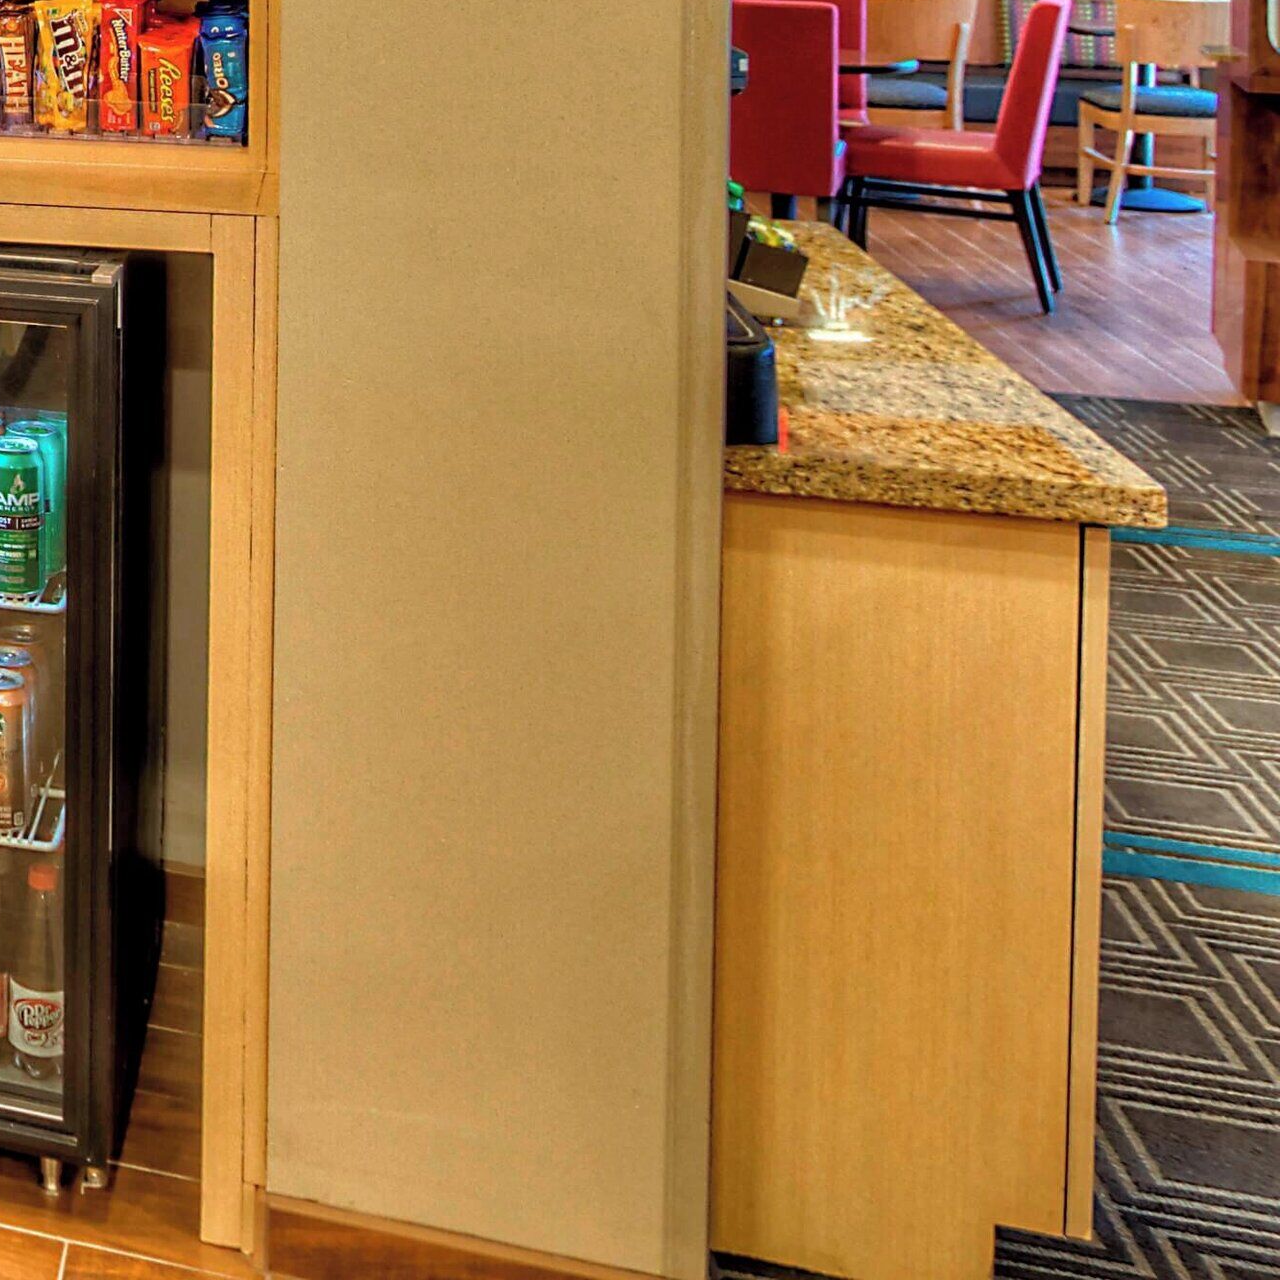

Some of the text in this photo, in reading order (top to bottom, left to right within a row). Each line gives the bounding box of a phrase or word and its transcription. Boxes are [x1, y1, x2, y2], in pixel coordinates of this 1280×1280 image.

[0, 36, 28, 112] HEATH
[111, 19, 131, 82] Nutter Butter
[213, 52, 229, 89] OREO
